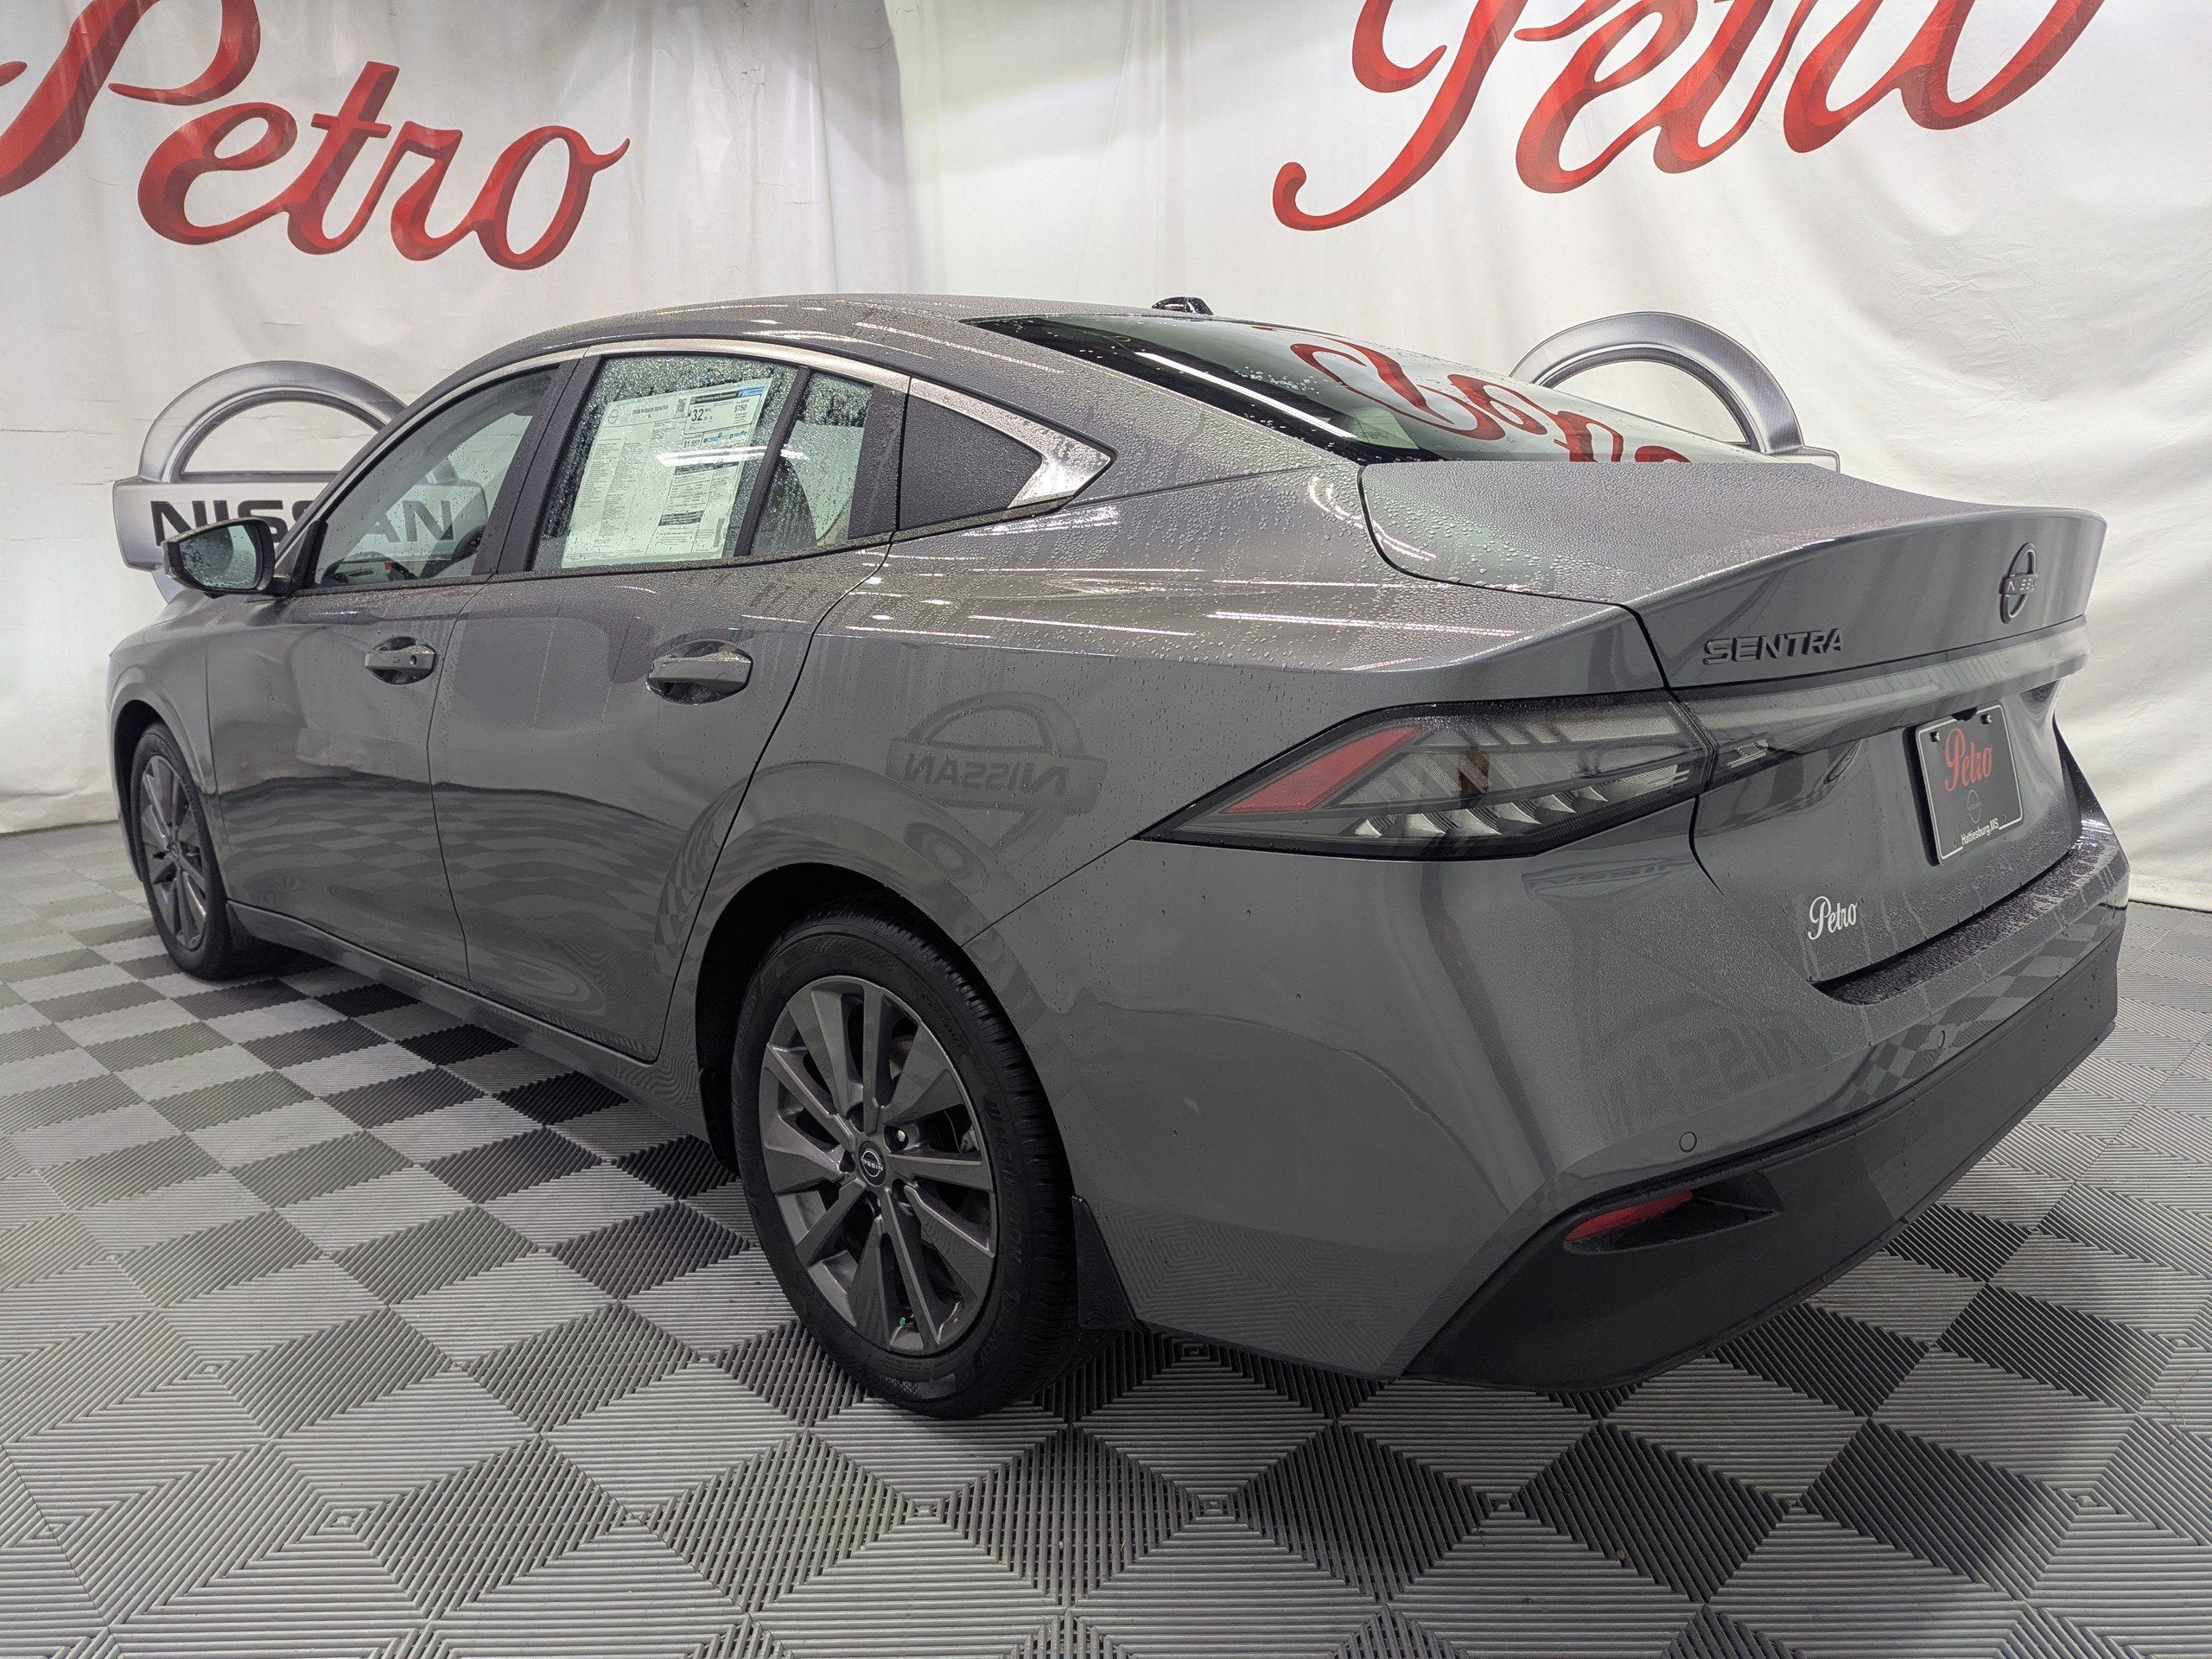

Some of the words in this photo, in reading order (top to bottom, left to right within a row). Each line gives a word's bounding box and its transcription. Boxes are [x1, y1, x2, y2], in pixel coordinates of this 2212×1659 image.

[691, 408, 704, 422] 32
[150, 499, 454, 548] NSAN
[1703, 627, 1843, 665] SENTRA
[1944, 728, 1993, 792] Petro
[1808, 895, 1858, 940] Petro
